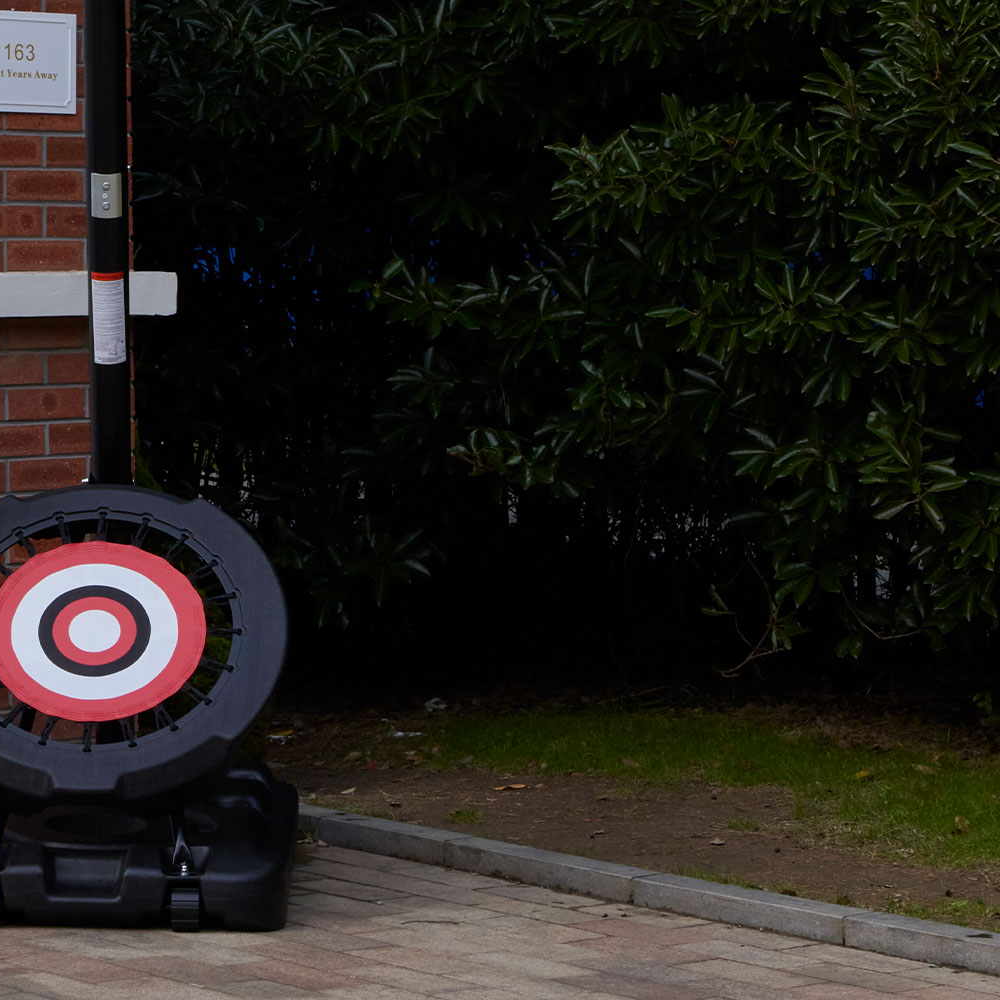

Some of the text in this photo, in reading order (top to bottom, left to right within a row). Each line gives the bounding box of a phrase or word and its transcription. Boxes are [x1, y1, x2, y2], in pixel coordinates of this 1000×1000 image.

[4, 43, 35, 61] 163
[7, 69, 32, 79] Years
[34, 71, 58, 81] Away
